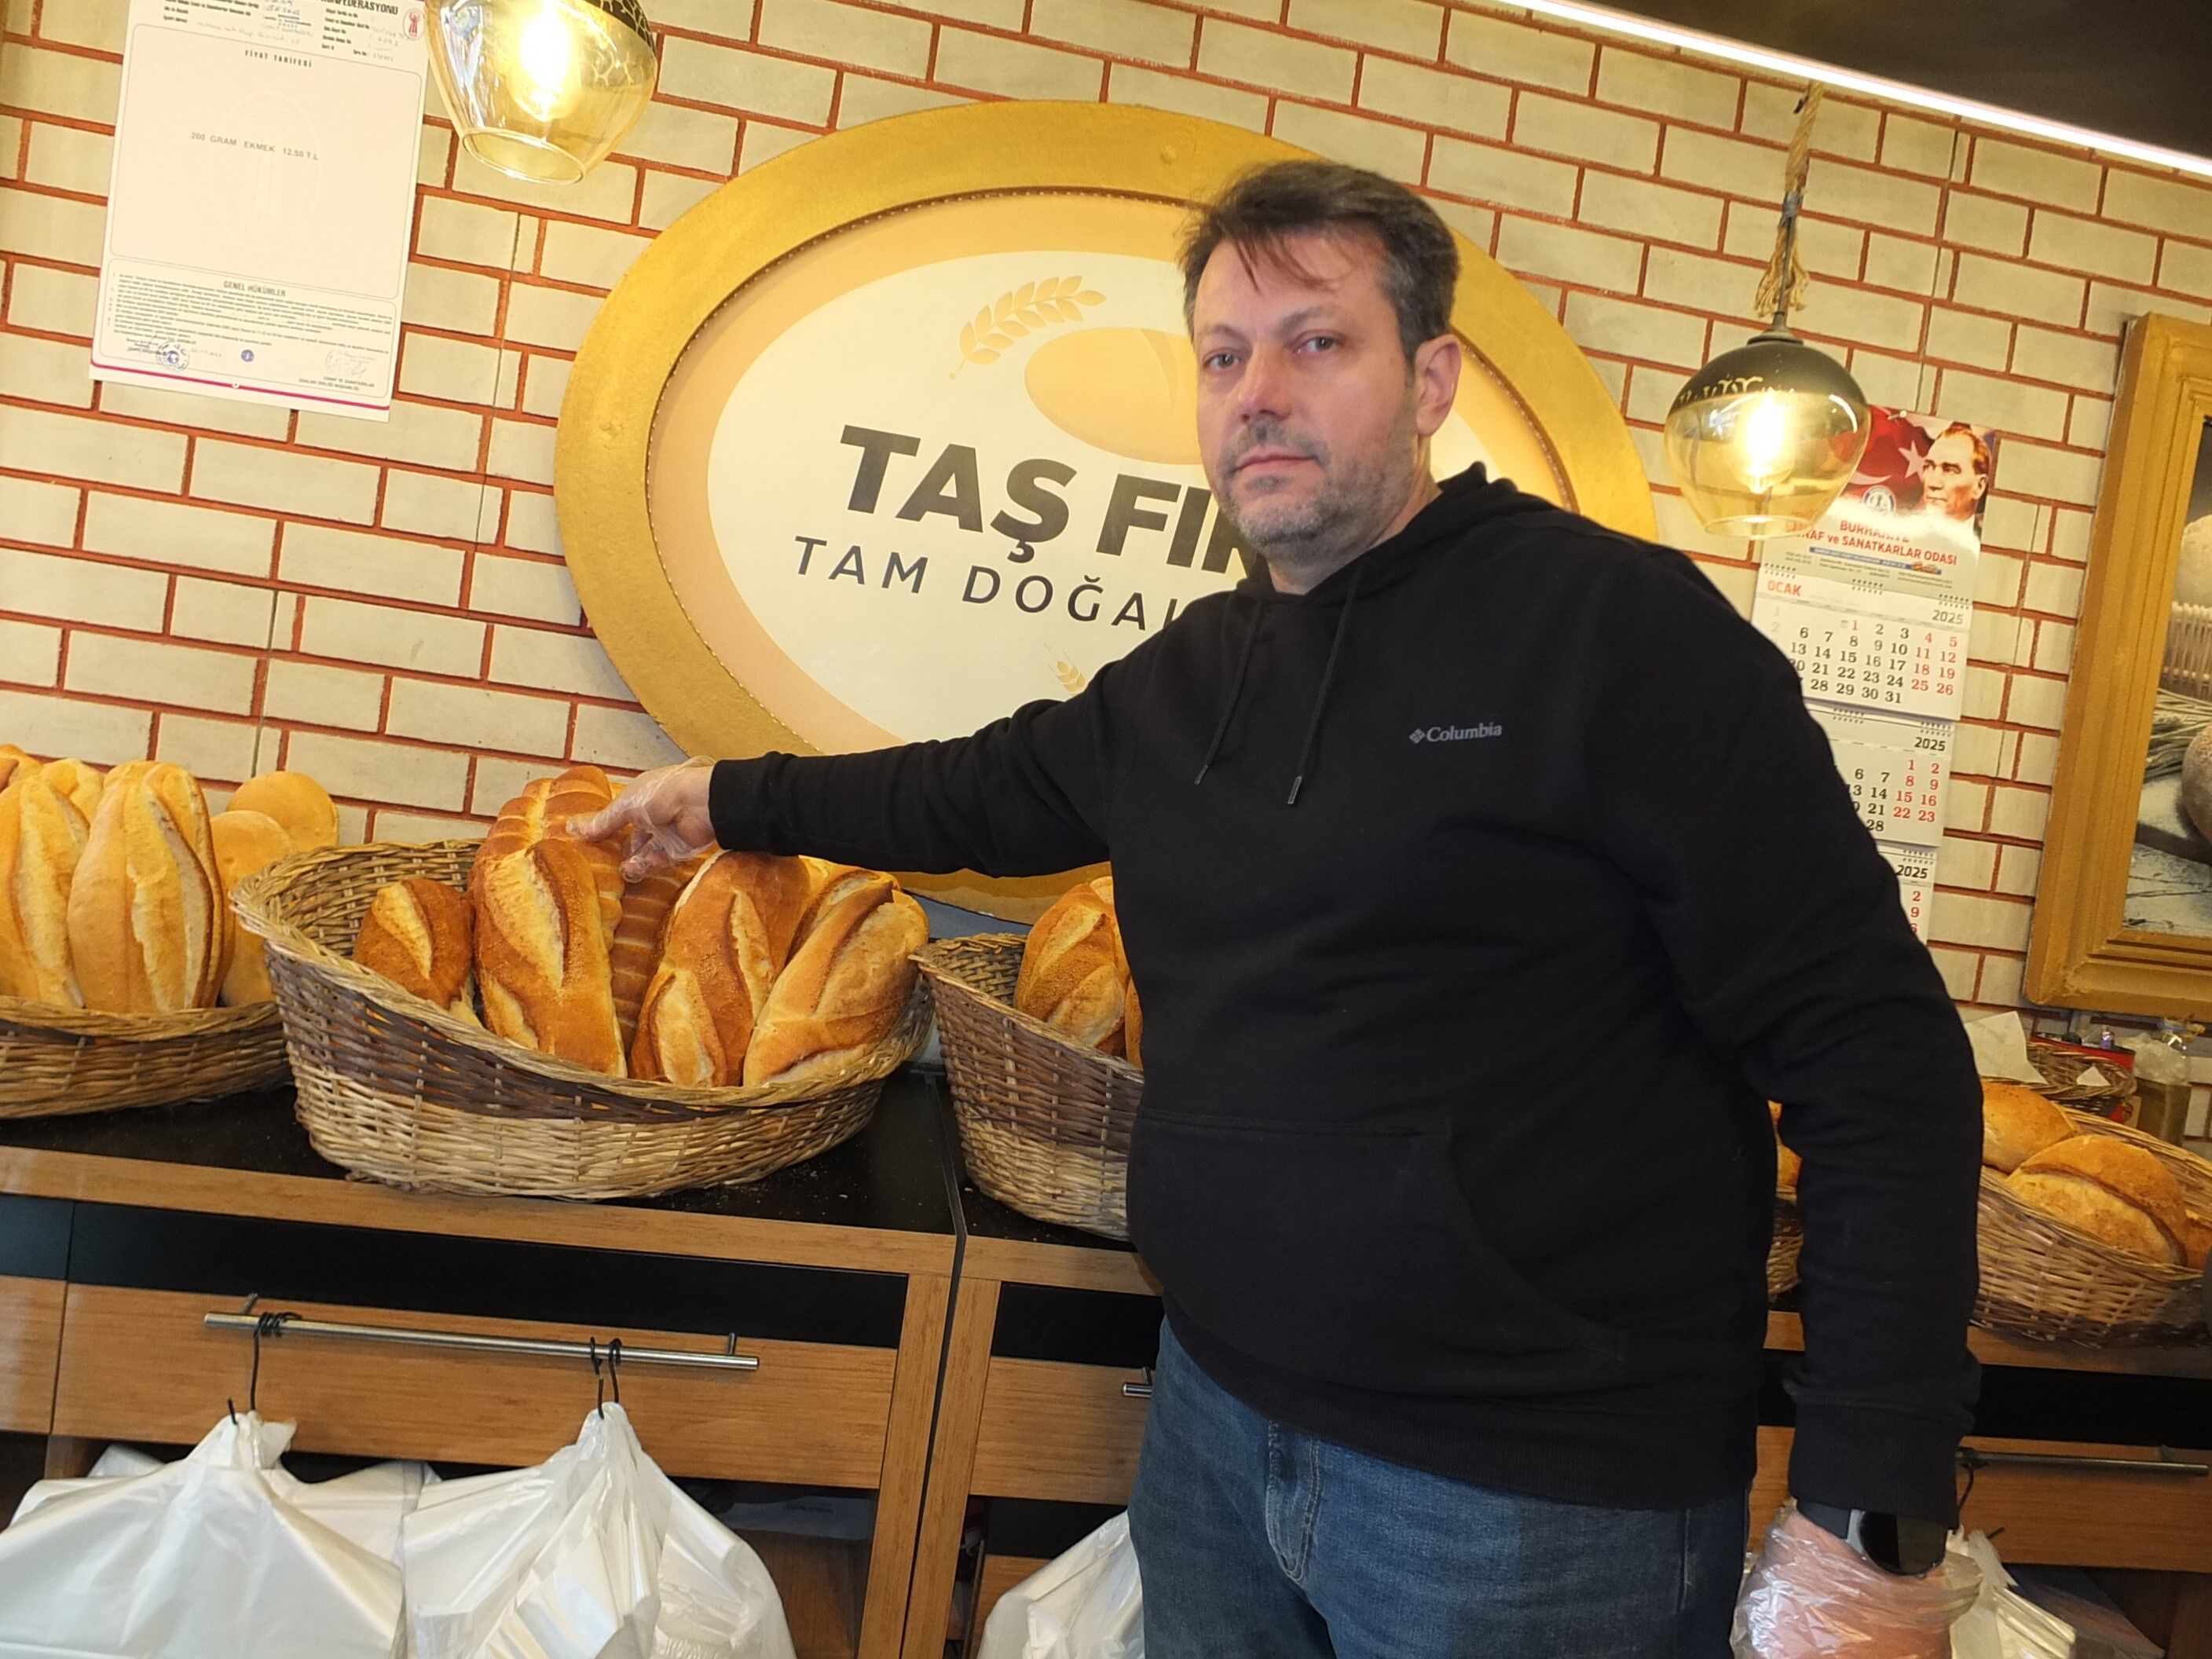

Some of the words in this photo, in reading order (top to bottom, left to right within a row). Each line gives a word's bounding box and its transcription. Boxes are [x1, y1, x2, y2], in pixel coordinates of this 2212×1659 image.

[318, 0, 398, 15] EDERASYONU
[210, 135, 237, 145] GRAM
[244, 141, 276, 152] EKMEK
[840, 425, 1078, 563] TAŞ
[1827, 534, 1839, 544] ve
[1842, 536, 1921, 558] SANATKARLAR
[1924, 551, 1957, 566] ODASI
[794, 536, 929, 594] TAM
[1767, 580, 1802, 596] OCAK
[1932, 610, 1964, 624] 2025
[1852, 620, 1858, 631] 1
[1876, 624, 1884, 635] 2
[1900, 628, 1910, 639] 3
[1925, 632, 1932, 643] 4
[1949, 636, 1957, 647] 5
[1799, 627, 1809, 639] 6
[1824, 631, 1833, 643] 7
[1849, 635, 1859, 647] 8
[1874, 639, 1883, 651] 9
[1891, 643, 1908, 655] 10
[1916, 646, 1931, 660] 11
[1940, 650, 1957, 664] 12
[1791, 642, 1807, 655] 13
[1815, 646, 1831, 659] 14
[1840, 650, 1857, 663] 15
[1866, 654, 1881, 668] 16
[1889, 658, 1906, 671] 17
[1914, 663, 1930, 676] 18
[1939, 667, 1955, 679] 19
[1812, 662, 1829, 676] 21
[1837, 666, 1855, 679] 22
[1863, 670, 1880, 683] 23
[1887, 675, 1903, 687] 24
[1911, 679, 1928, 692] 25
[1936, 683, 1954, 696] 26
[1811, 679, 1829, 692] 28
[1837, 683, 1855, 695] 29
[1862, 687, 1879, 700] 30
[1885, 690, 1902, 704] 31
[1426, 722, 1503, 742] Columbia
[1914, 737, 1946, 752] 2025
[1908, 760, 1914, 771] 1
[1932, 763, 1939, 775] 2
[1855, 768, 1864, 780] 6
[1881, 771, 1890, 783] 7
[1906, 775, 1914, 787] 8
[1930, 779, 1939, 790] 9
[1871, 787, 1887, 800] 14
[1896, 790, 1913, 803] 15
[1921, 794, 1937, 807] 16
[1868, 803, 1884, 815] 21
[1893, 806, 1911, 819] 22
[1918, 810, 1936, 822] 23
[1866, 819, 1884, 832] 28
[1896, 864, 1928, 879] 2025
[1912, 890, 1921, 902] 2
[1910, 906, 1920, 918] 9
